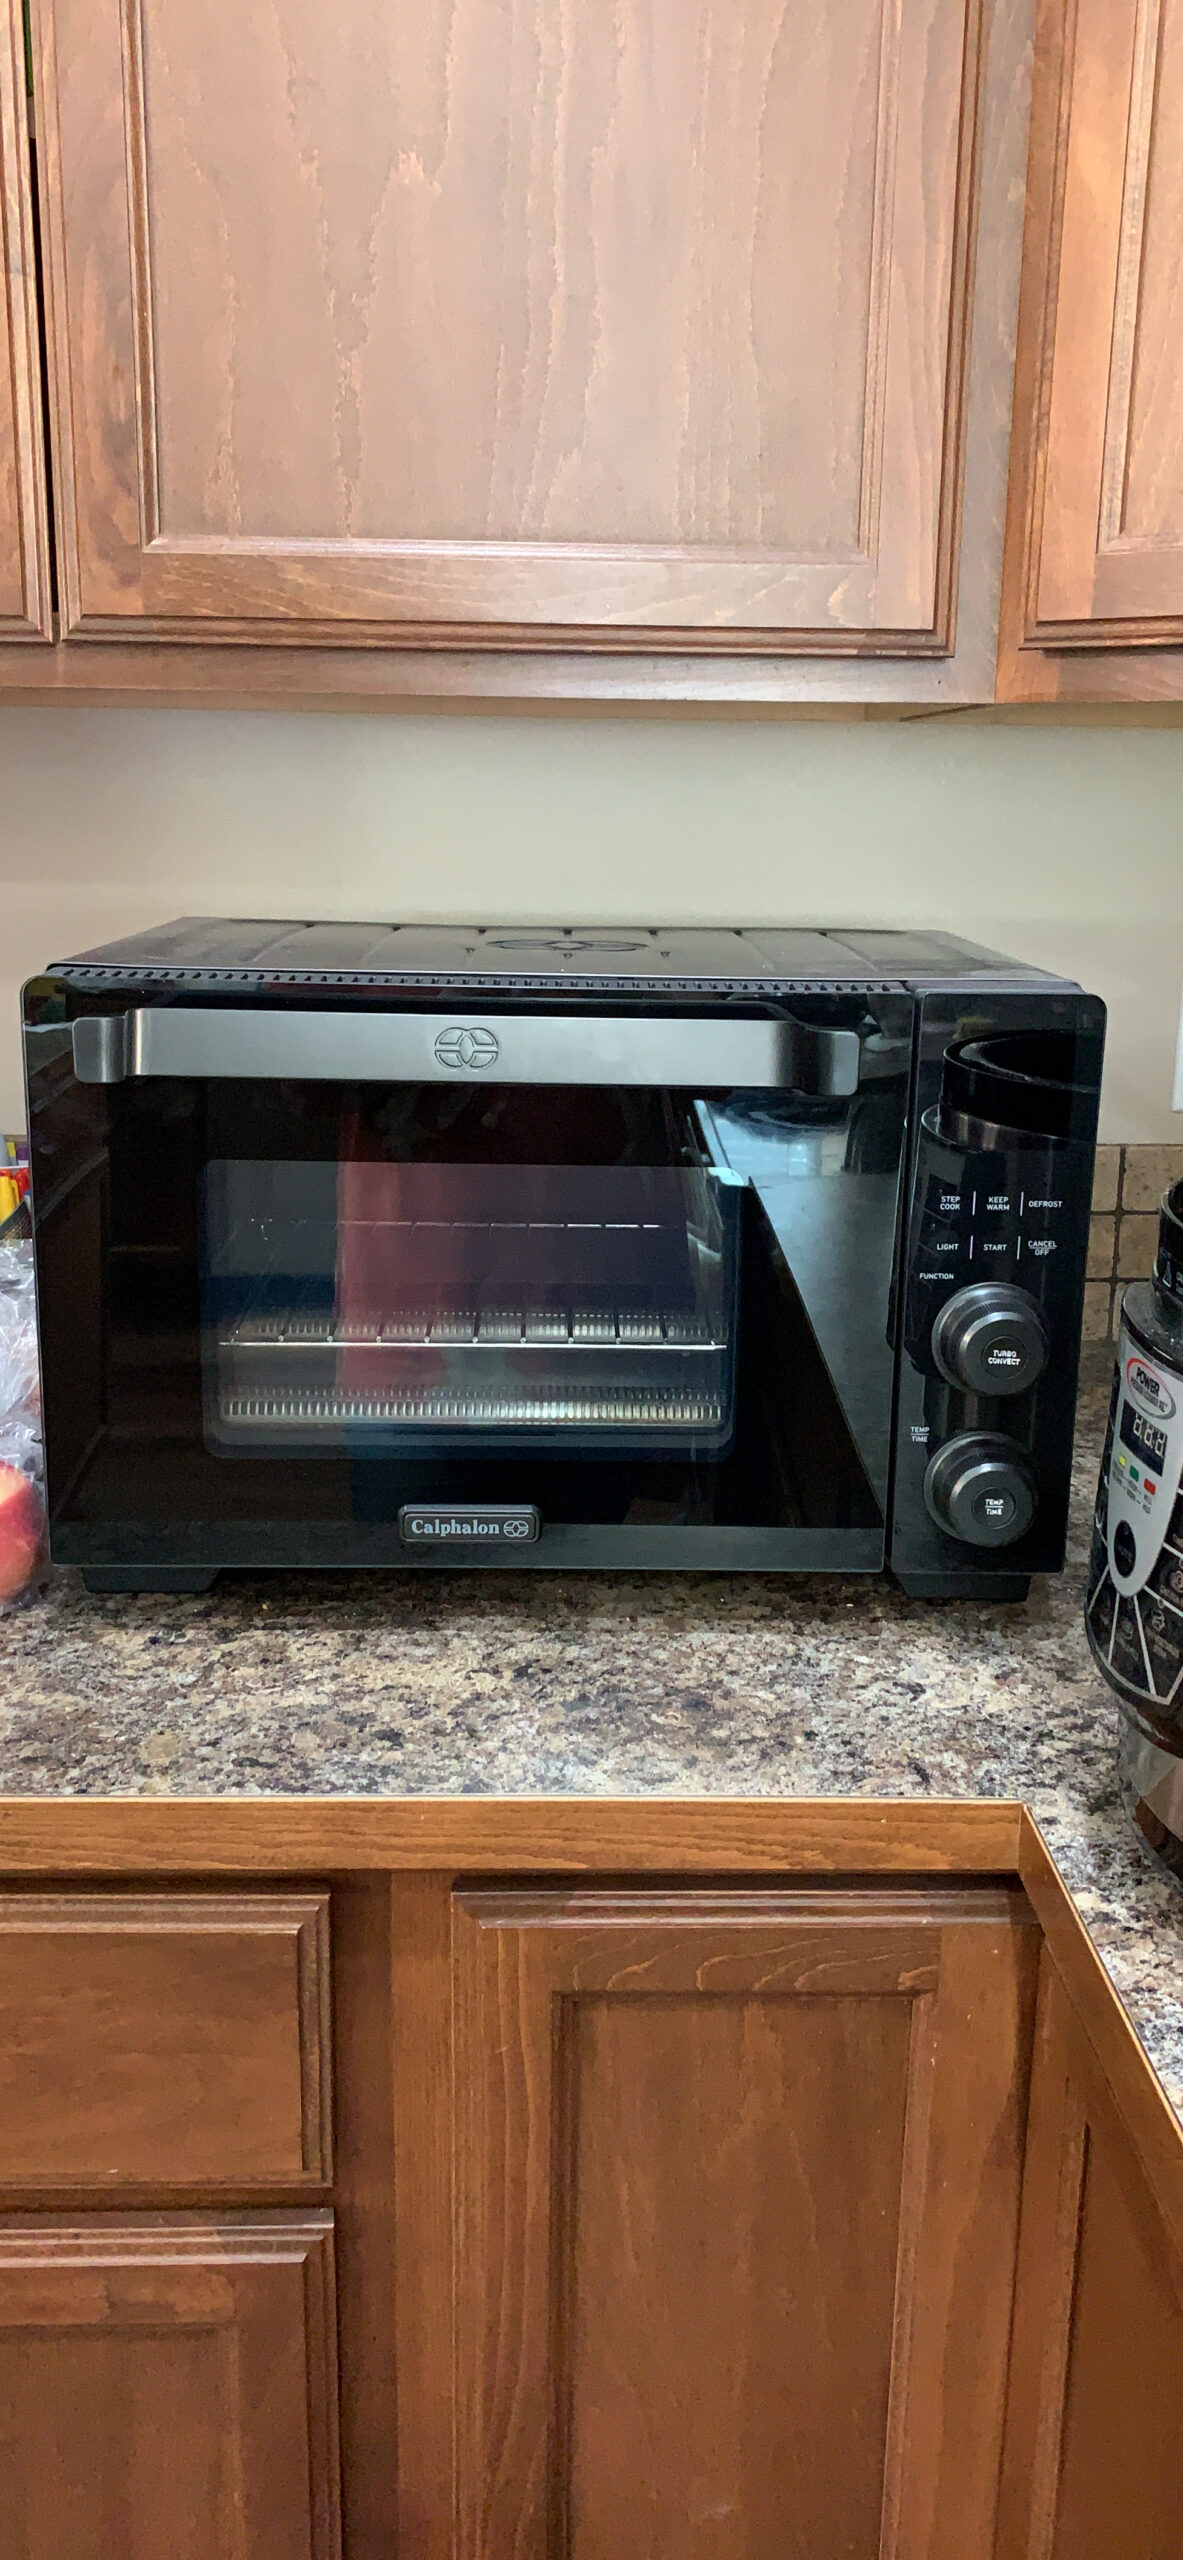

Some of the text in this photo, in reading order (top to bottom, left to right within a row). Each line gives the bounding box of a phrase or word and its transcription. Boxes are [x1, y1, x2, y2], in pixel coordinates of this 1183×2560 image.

[940, 1195, 961, 1203] STEP
[939, 1203, 961, 1211] COOK
[1028, 1200, 1063, 1208] DEFROST
[936, 1243, 960, 1251] LIGHT
[983, 1243, 1008, 1251] START
[1027, 1240, 1058, 1248] CANCEL
[919, 1272, 955, 1280] FUNCTION
[993, 1349, 1017, 1358] TURBO
[987, 1357, 1021, 1366] CONVECT
[1136, 1366, 1160, 1397] POWER
[910, 1426, 930, 1434] TEMP
[911, 1435, 928, 1443] TIME
[986, 1508, 1003, 1516] TIME
[411, 1518, 500, 1537] Calphalon
